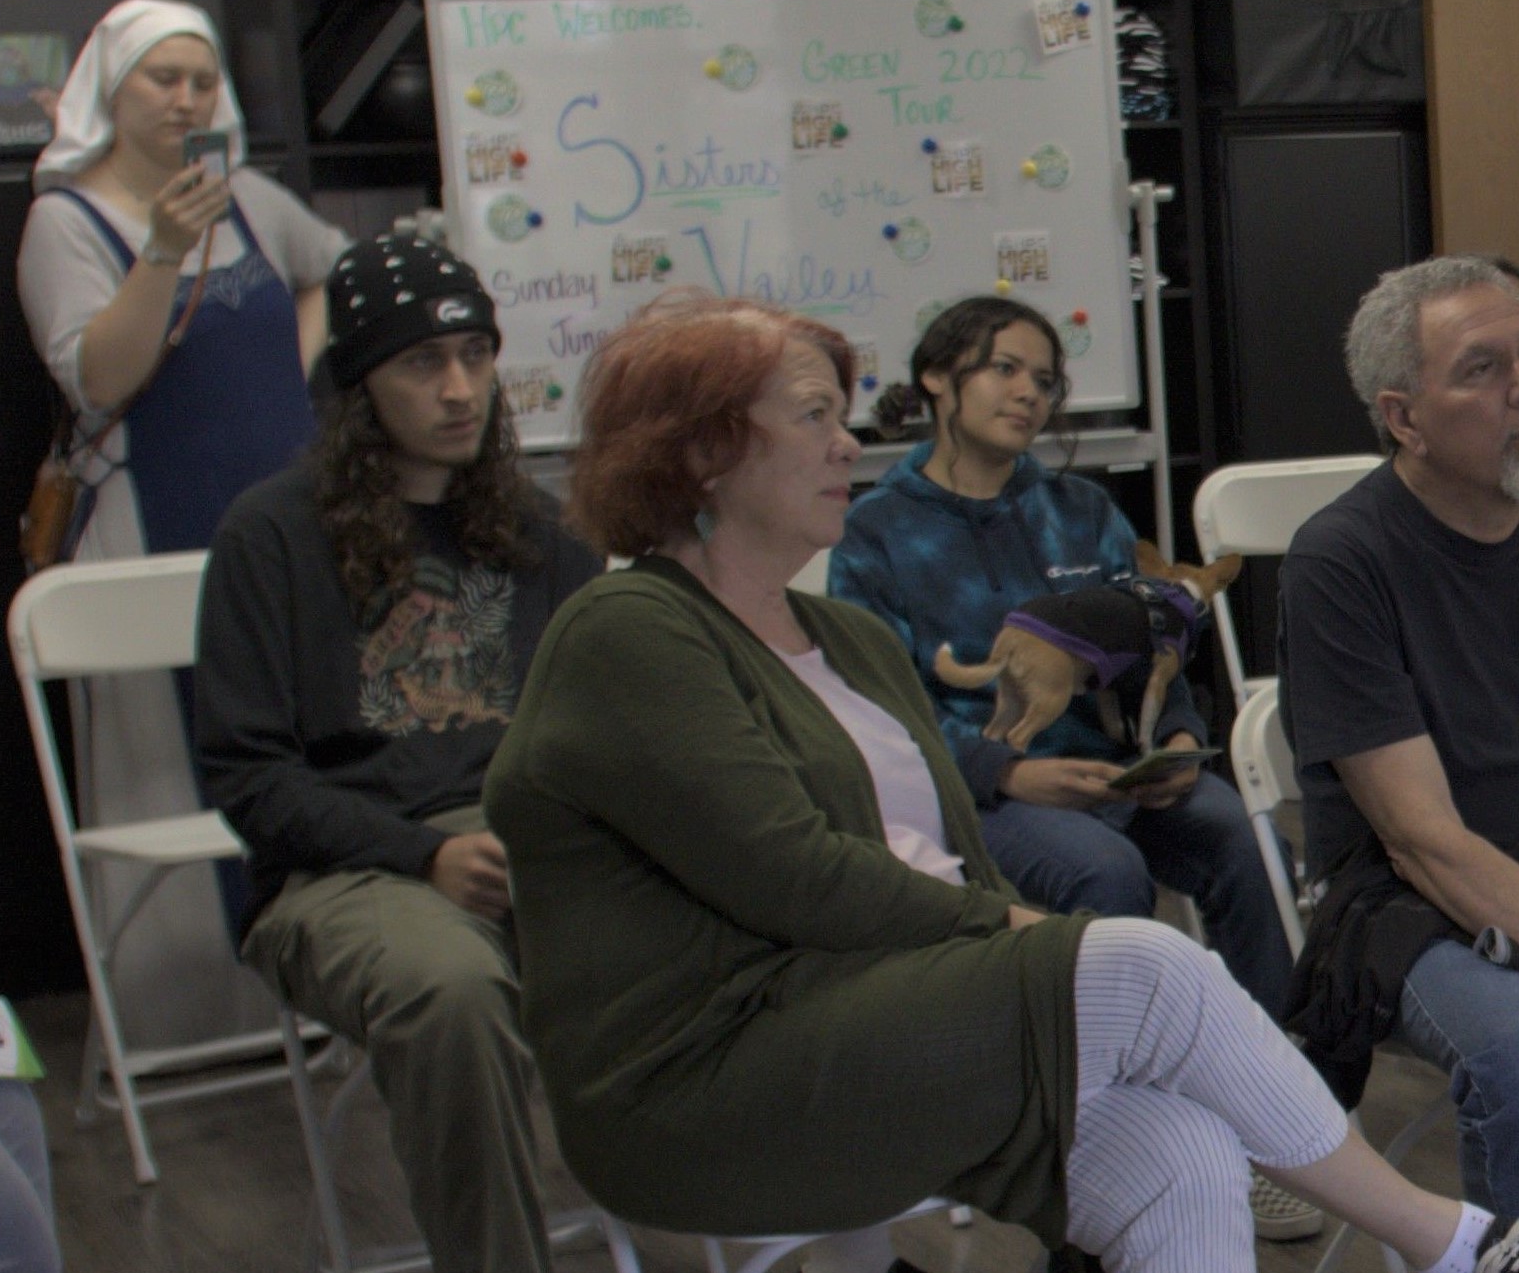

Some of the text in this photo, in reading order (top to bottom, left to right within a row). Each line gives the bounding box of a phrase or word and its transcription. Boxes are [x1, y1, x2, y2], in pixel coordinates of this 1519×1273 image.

[937, 44, 1047, 84] 2022
[556, 92, 779, 227] Sisters
[932, 174, 985, 194] LIFE
[492, 268, 599, 309] Sunday
